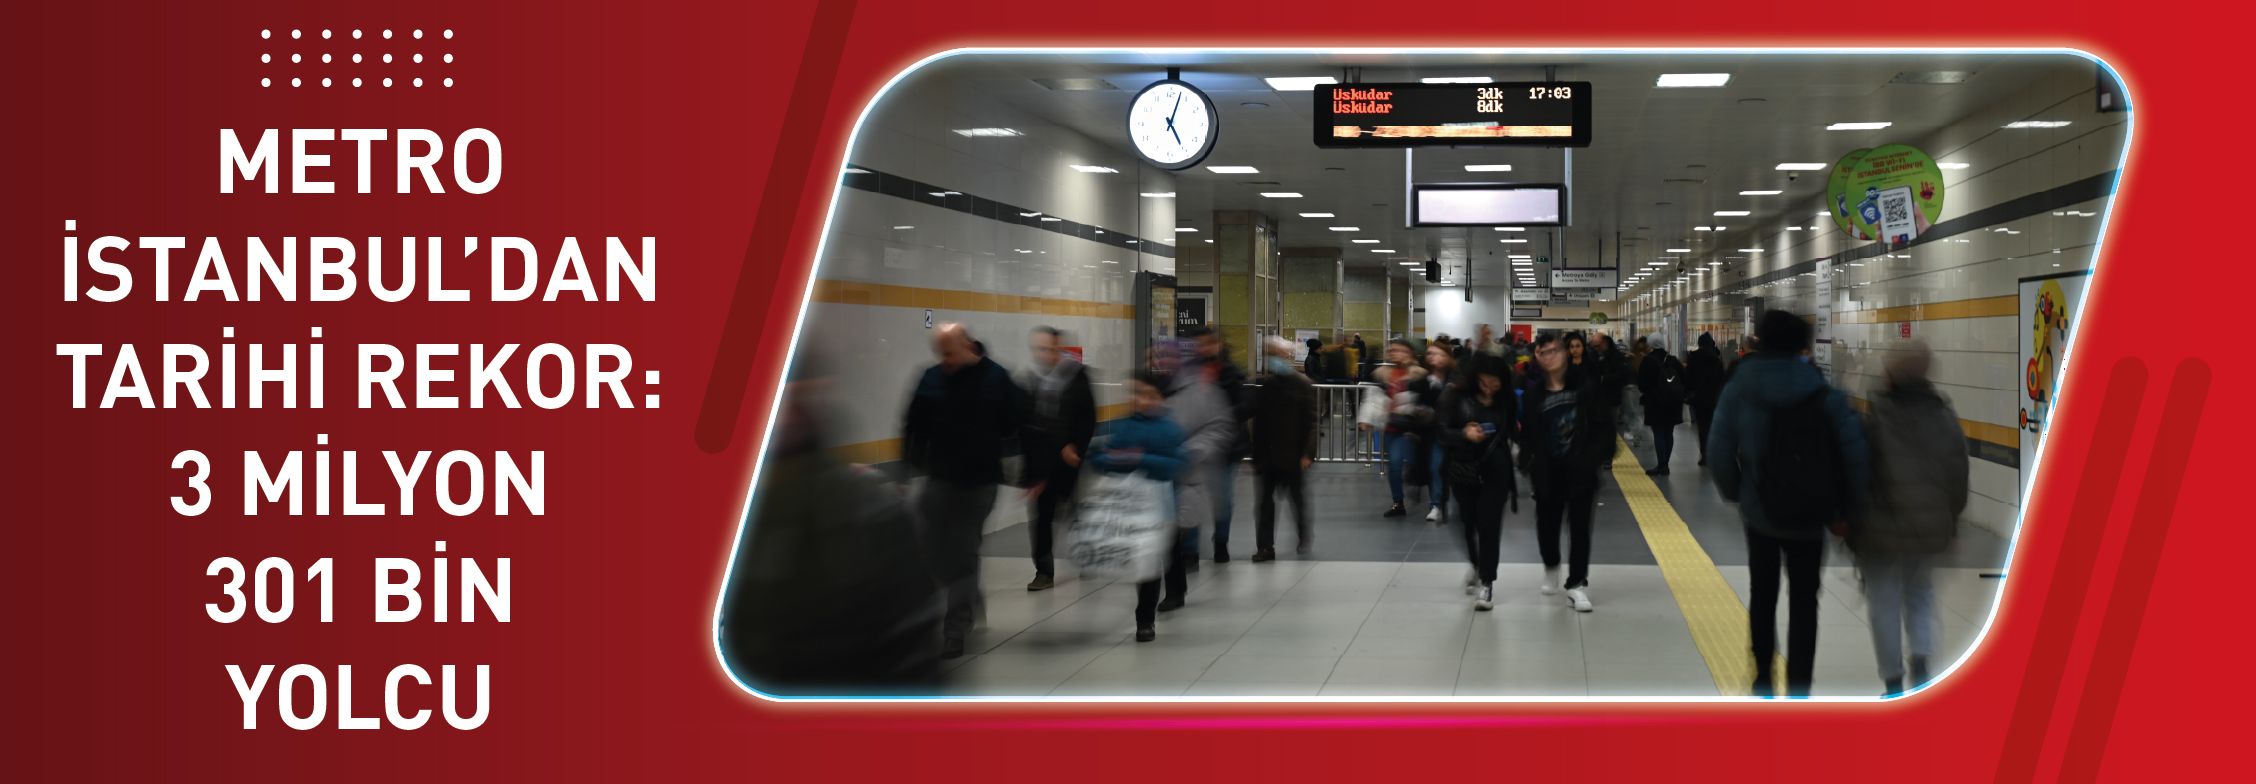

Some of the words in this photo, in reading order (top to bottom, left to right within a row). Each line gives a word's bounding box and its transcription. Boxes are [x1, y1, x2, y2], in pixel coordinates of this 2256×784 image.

[1477, 88, 1503, 99] 3dk
[1529, 87, 1571, 99] 17:03
[1333, 101, 1393, 113] Üsküdar
[1477, 100, 1503, 112] 8dk
